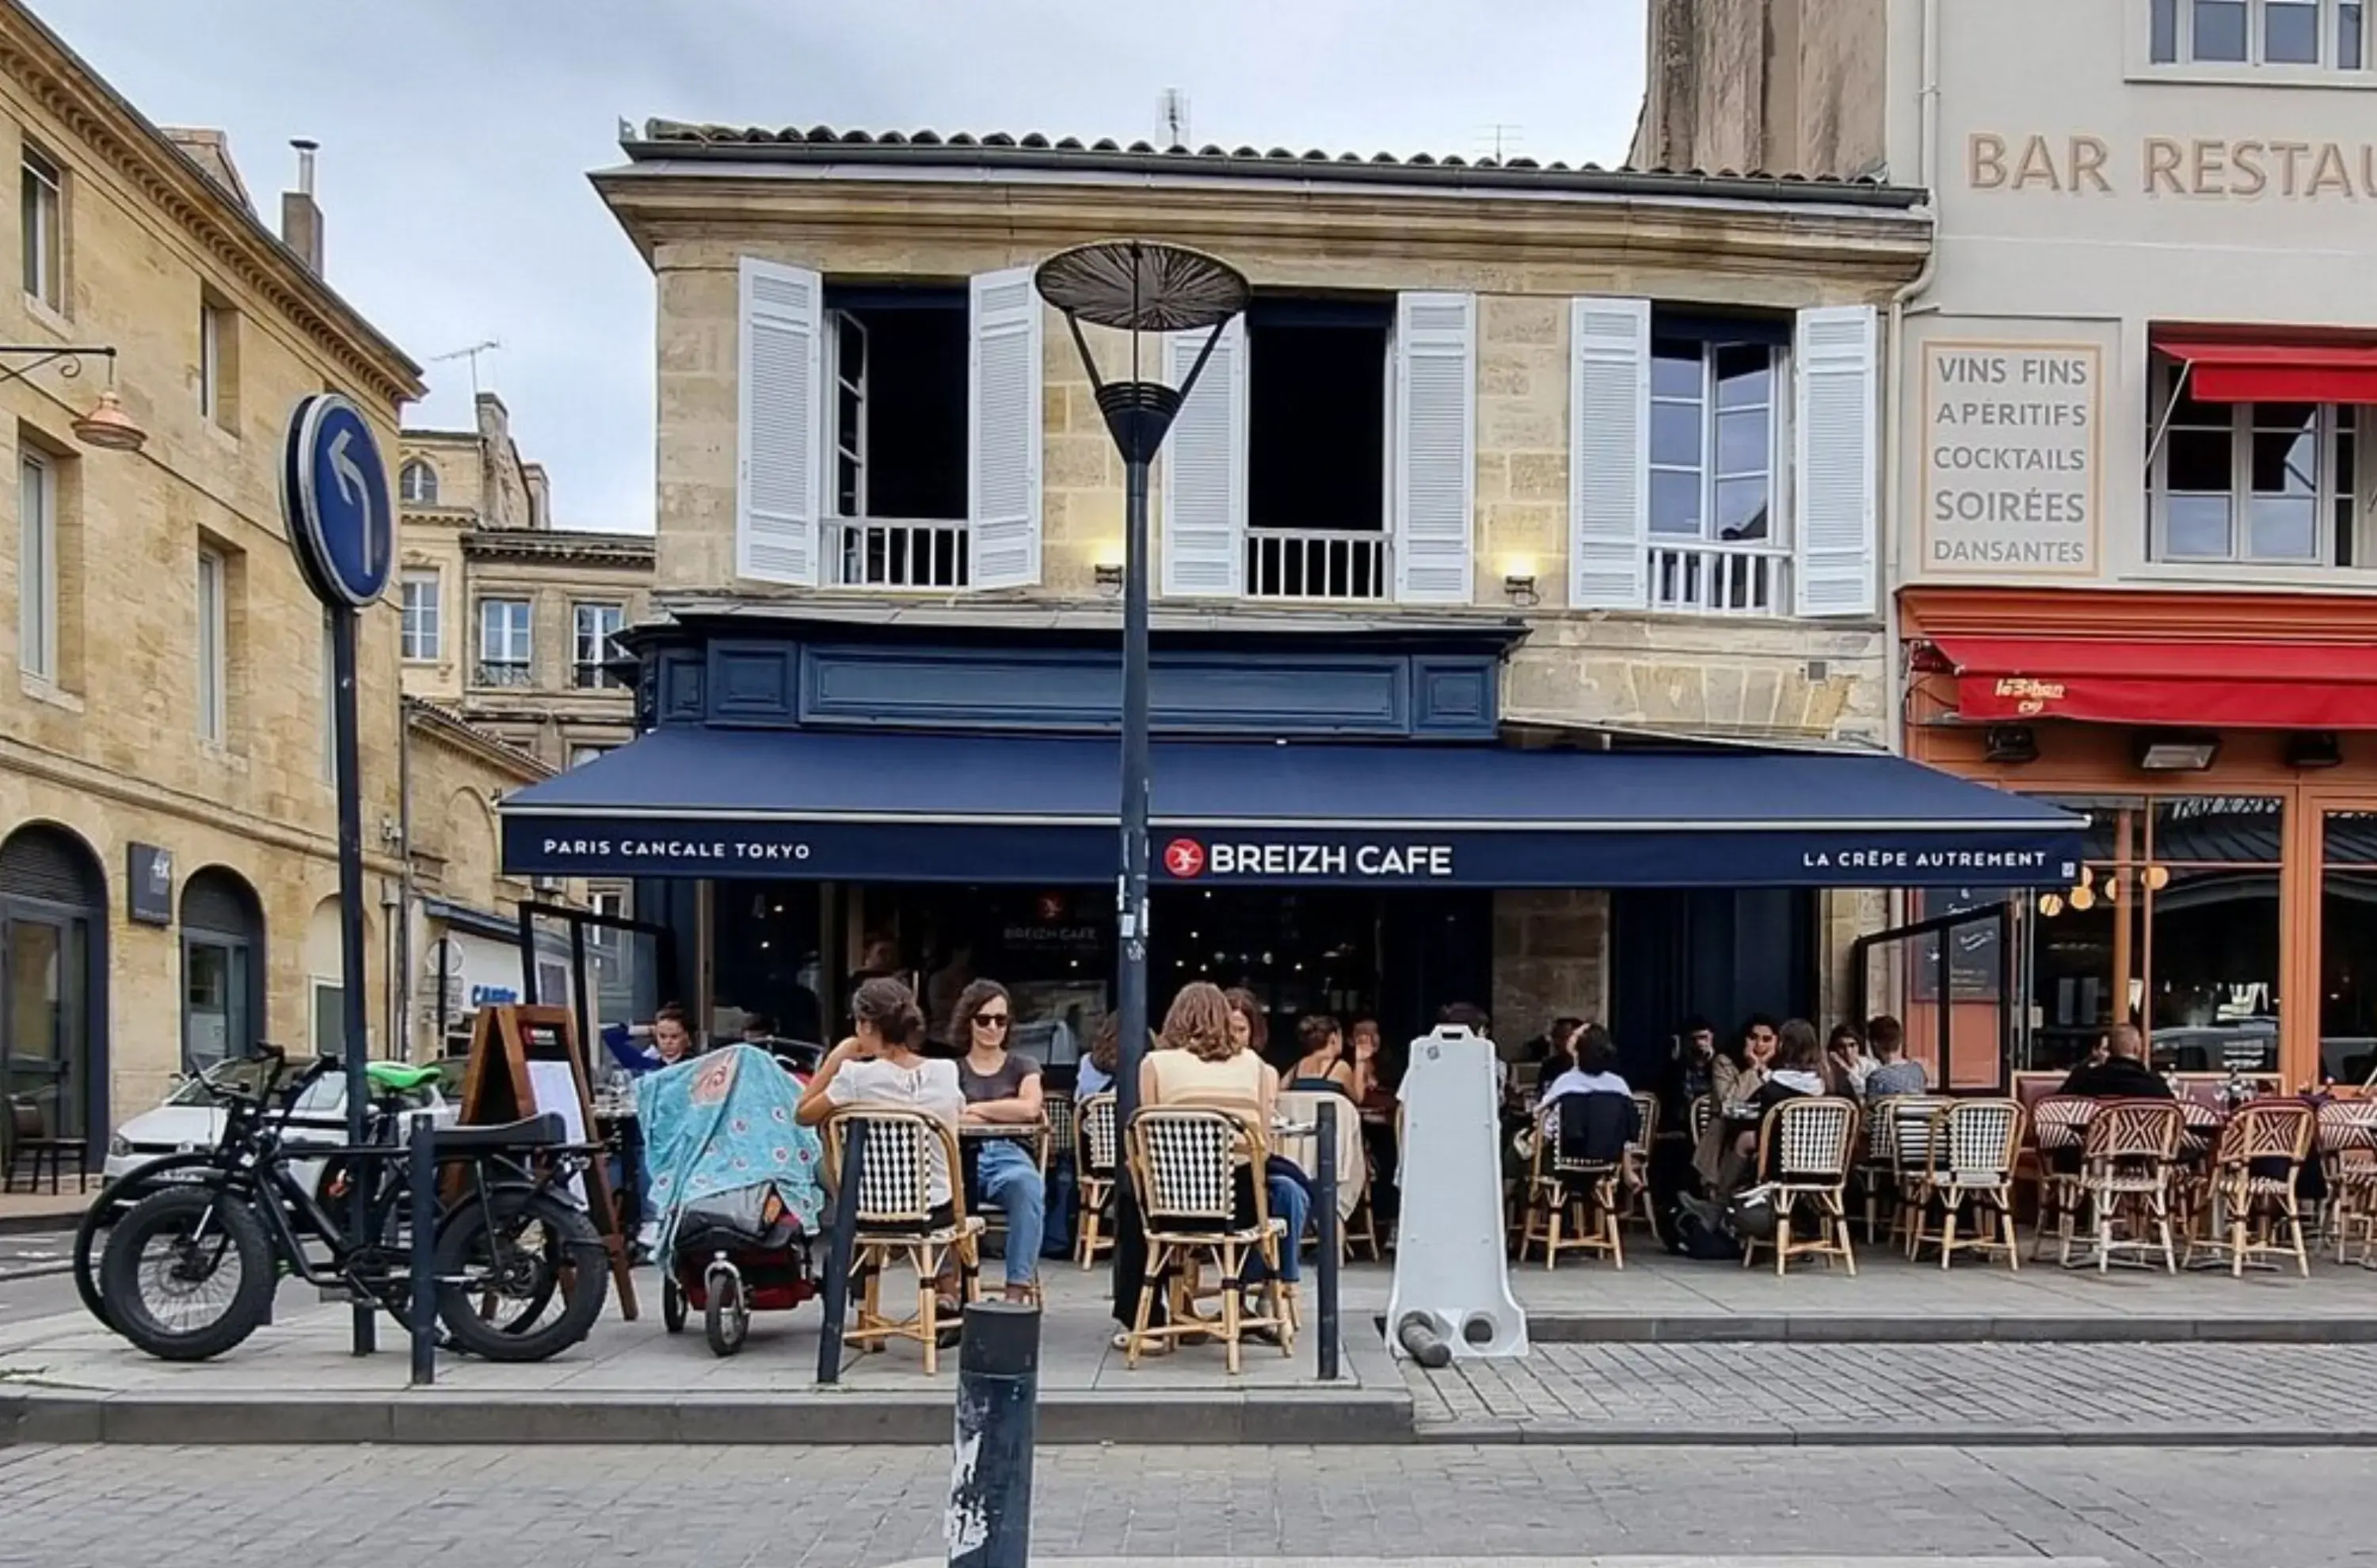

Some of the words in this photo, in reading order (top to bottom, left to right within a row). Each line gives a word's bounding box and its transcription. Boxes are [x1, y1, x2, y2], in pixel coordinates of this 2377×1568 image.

[1967, 131, 2114, 194] BAR
[1937, 357, 2006, 383] VINS
[2022, 359, 2087, 385] FINS
[1933, 446, 2085, 470] COCKTAILS
[1934, 486, 2085, 523] SOIRÉES
[1933, 539, 2085, 562] DANSANTES
[543, 839, 611, 854] PARIS
[620, 840, 726, 858] CANCALE
[735, 843, 810, 859] TOKYO
[1210, 844, 1346, 874] BREIZH
[1355, 845, 1453, 875] CAFE
[1803, 852, 1830, 866] LA
[1915, 851, 2046, 866] AUTREMENT
